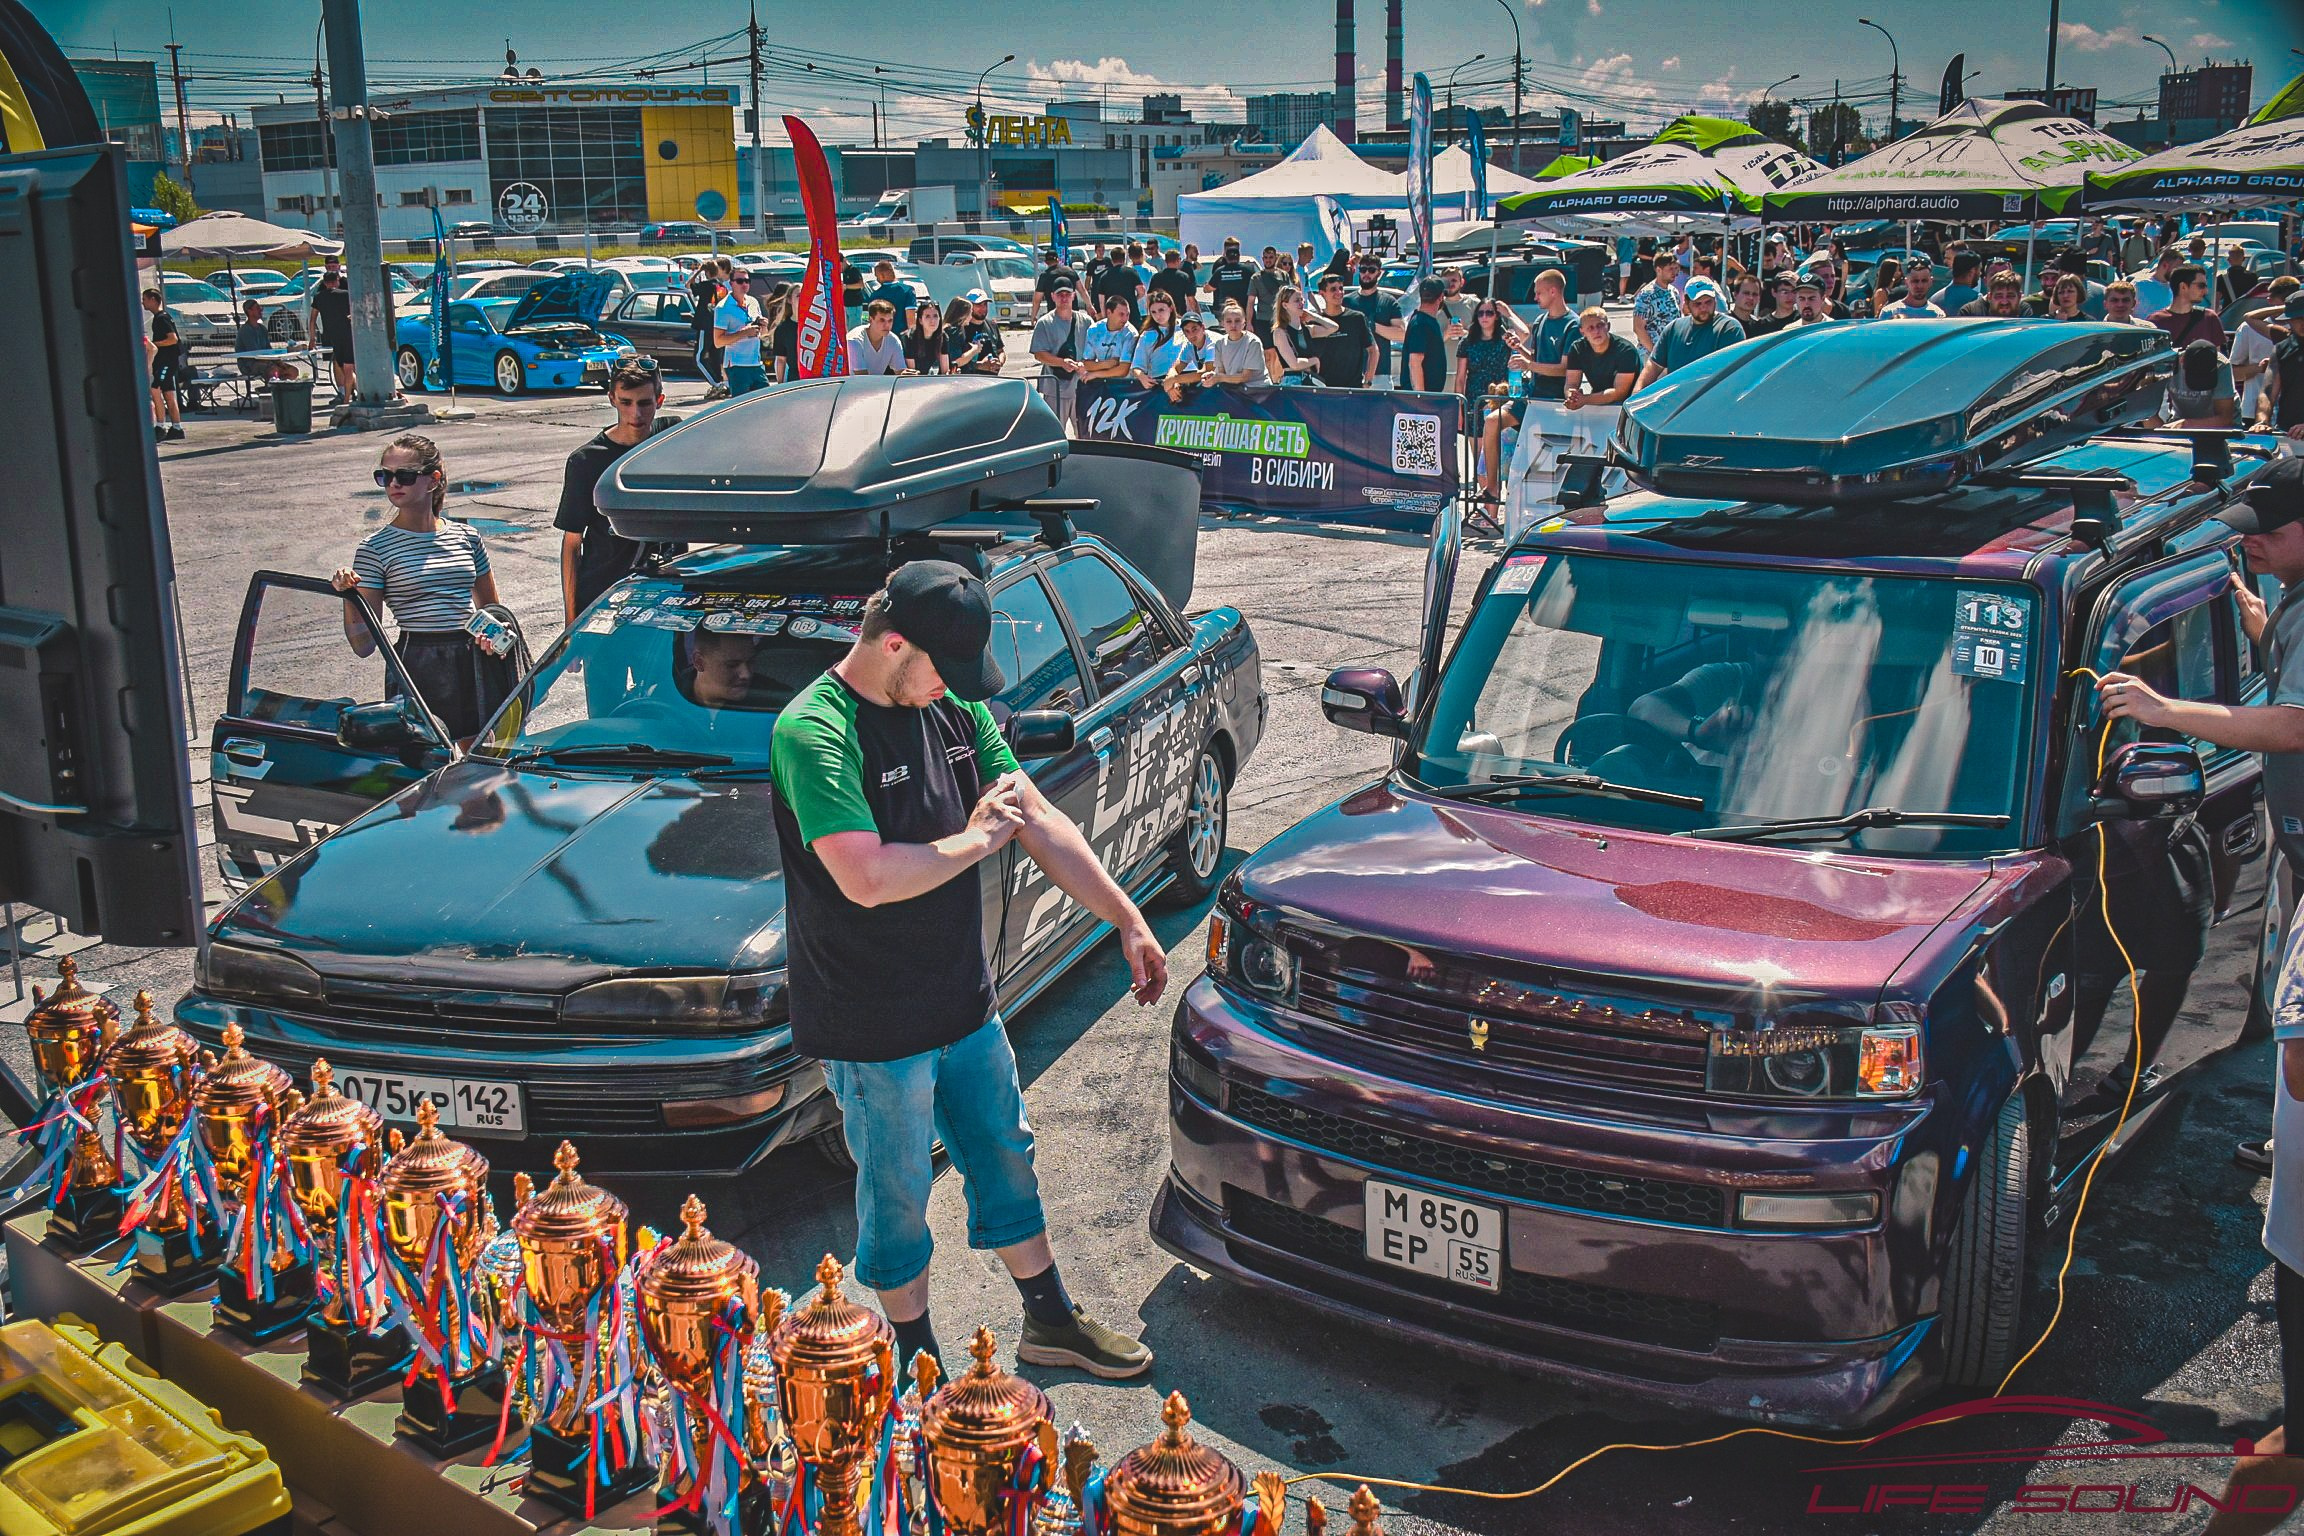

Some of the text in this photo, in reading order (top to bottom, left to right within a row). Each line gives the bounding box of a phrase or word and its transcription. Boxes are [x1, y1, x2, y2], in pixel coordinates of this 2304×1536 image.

[985, 116, 1072, 145] ЛЕНТА
[2153, 175, 2304, 189] ALPHARD GROU
[506, 194, 542, 214] 24
[1548, 195, 1668, 209] ALPHARD GROUP
[1828, 195, 1960, 213] http://alphard.audio
[508, 212, 540, 223] часа
[1086, 396, 1142, 441] 12K
[1155, 416, 1306, 454] КРУПНЕЙШАЯ СЕТЬ
[1251, 458, 1335, 491] В СИБИРИ
[745, 599, 771, 608] 054
[833, 600, 860, 610] 050
[704, 614, 732, 625] 045
[1963, 601, 2023, 629] 113
[791, 620, 818, 632] 064
[1981, 649, 1997, 665] 10
[458, 1085, 510, 1115] 142
[476, 1113, 504, 1126] RUS
[1384, 1188, 1479, 1239] М 850
[1459, 1247, 1489, 1275] 55
[1455, 1269, 1476, 1282] RUS
